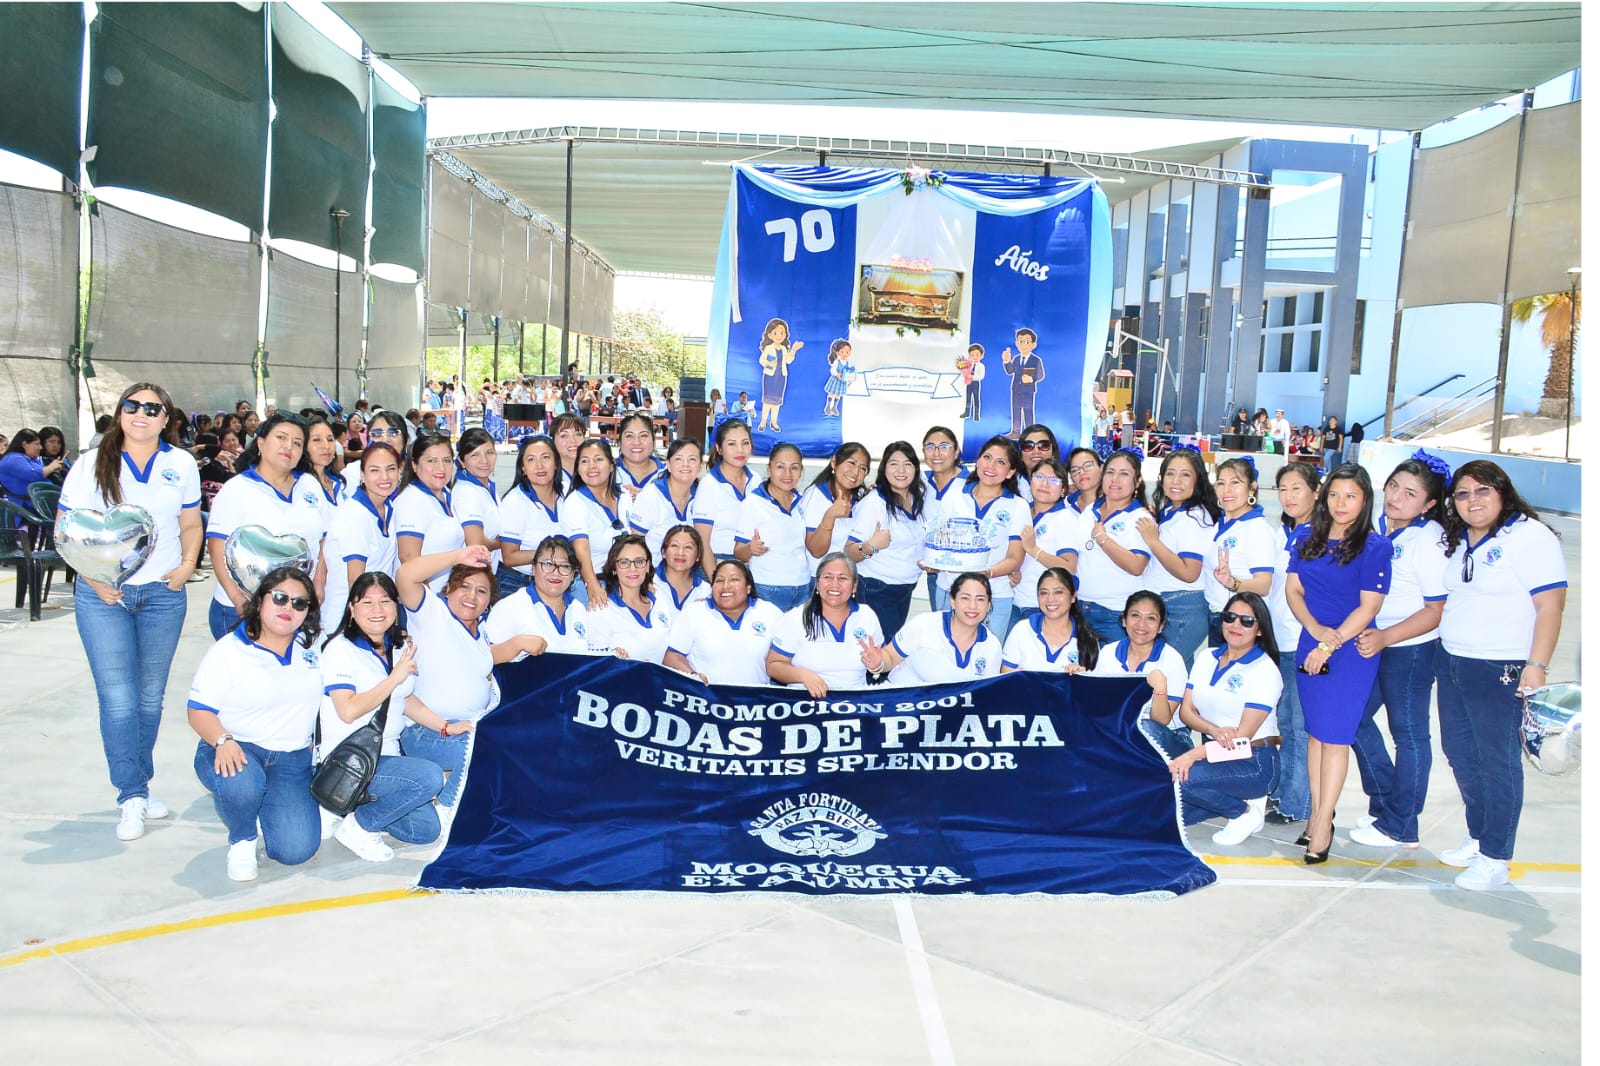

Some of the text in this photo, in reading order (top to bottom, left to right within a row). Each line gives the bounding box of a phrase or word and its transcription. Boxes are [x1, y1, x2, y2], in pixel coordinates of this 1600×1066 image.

[764, 208, 836, 263] 70
[994, 245, 1050, 281] Años
[662, 688, 975, 721] PROMOCIÓN 2001
[572, 689, 1065, 756] BODAS DE PLATA
[614, 739, 1018, 776] VERITATIS SPLENDOR
[750, 797, 796, 829] SANTA
[775, 812, 804, 829] PAZ
[809, 808, 819, 819] Y
[681, 873, 972, 889] EX ALUMNAS
[690, 861, 962, 878] MOQUEGUA
